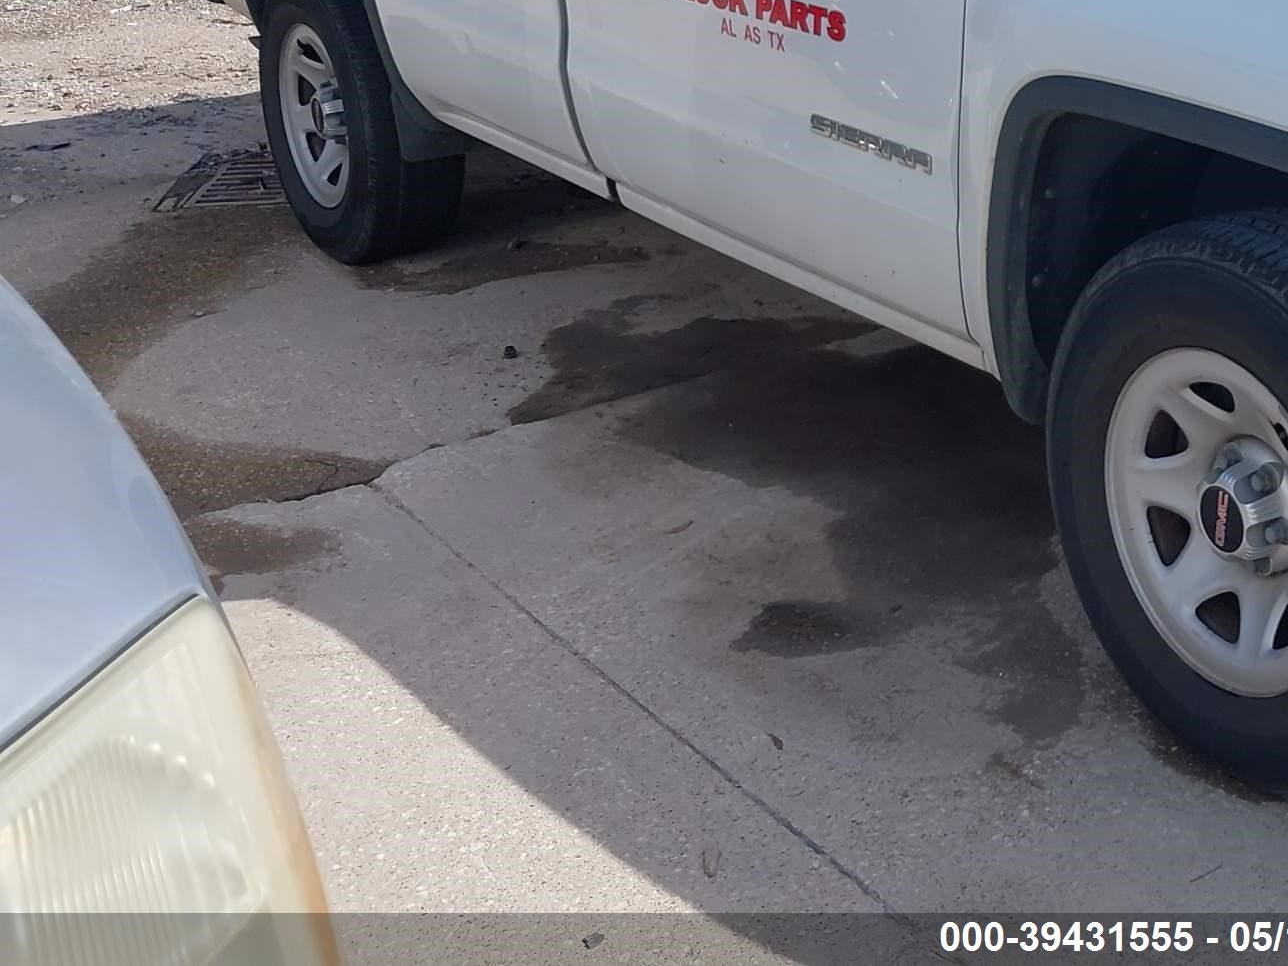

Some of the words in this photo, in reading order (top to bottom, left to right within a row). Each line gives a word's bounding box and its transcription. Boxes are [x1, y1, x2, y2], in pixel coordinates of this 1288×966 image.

[721, 18, 736, 38] AL
[744, 25, 761, 44] AS
[768, 31, 785, 52] TX
[810, 113, 933, 175] SIERRA
[1215, 491, 1229, 546] GMC
